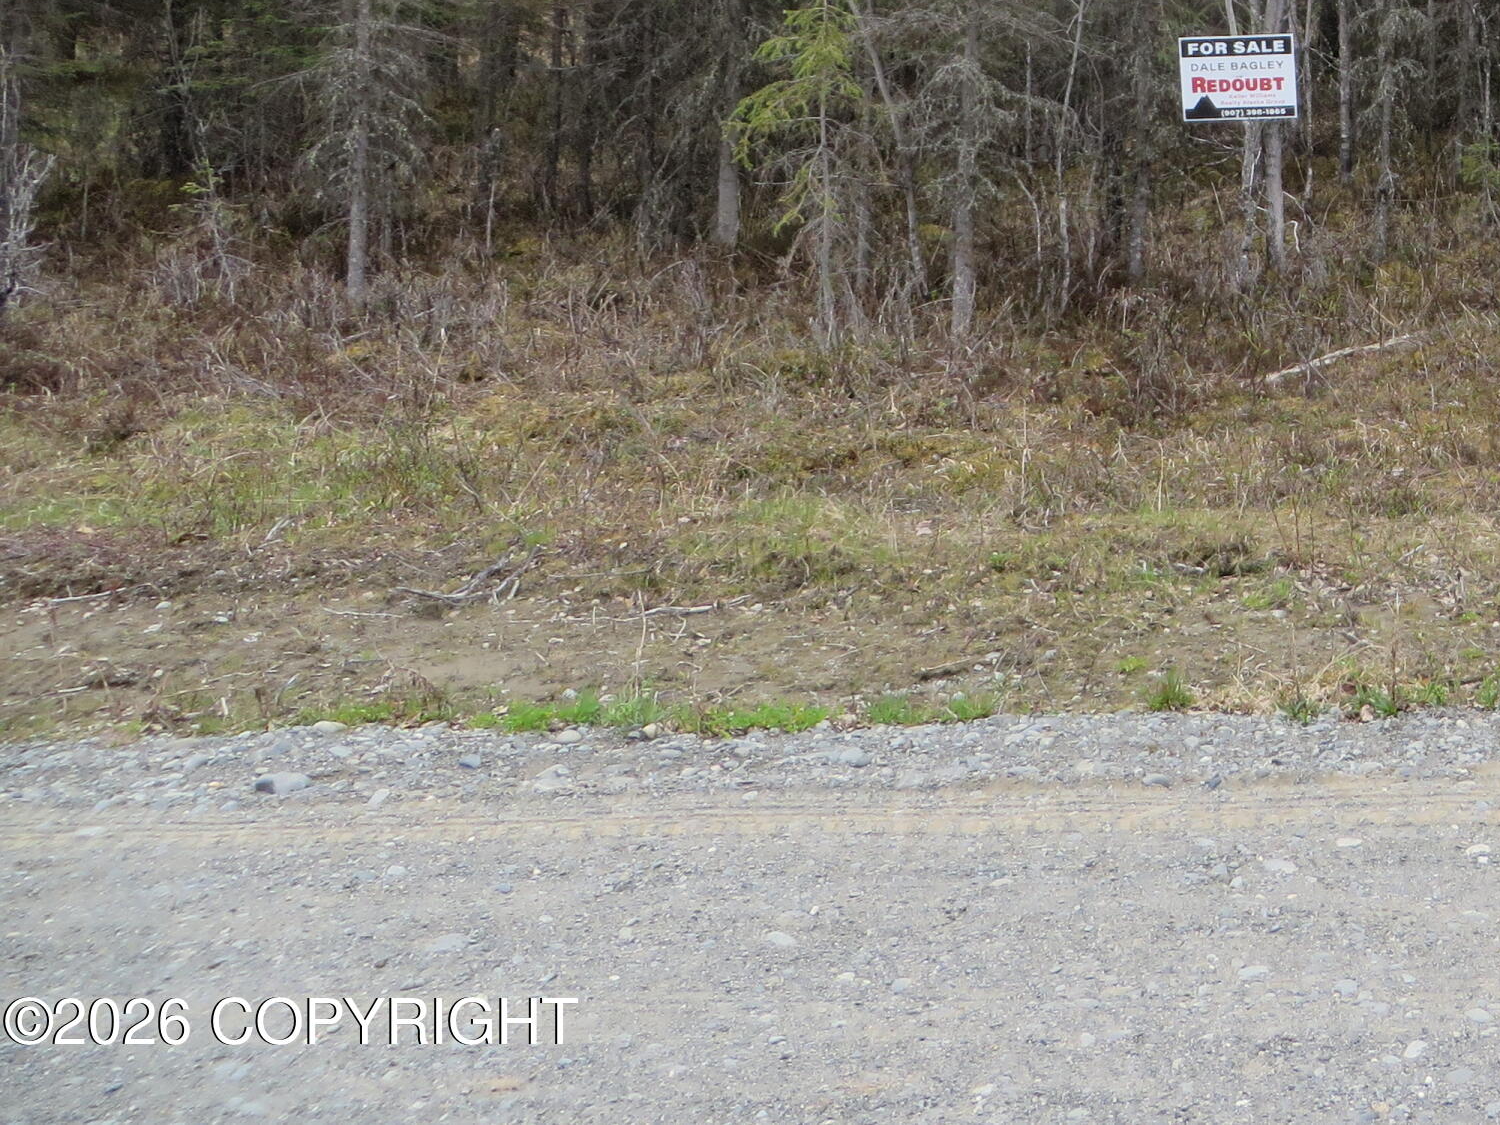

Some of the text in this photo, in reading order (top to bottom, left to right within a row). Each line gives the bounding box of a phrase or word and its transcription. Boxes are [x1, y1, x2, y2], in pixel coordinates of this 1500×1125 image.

[1187, 40, 1285, 55] FOR SALE
[1190, 60, 1284, 72] DALE BAGLEY
[1191, 76, 1285, 93] REDOUBT
